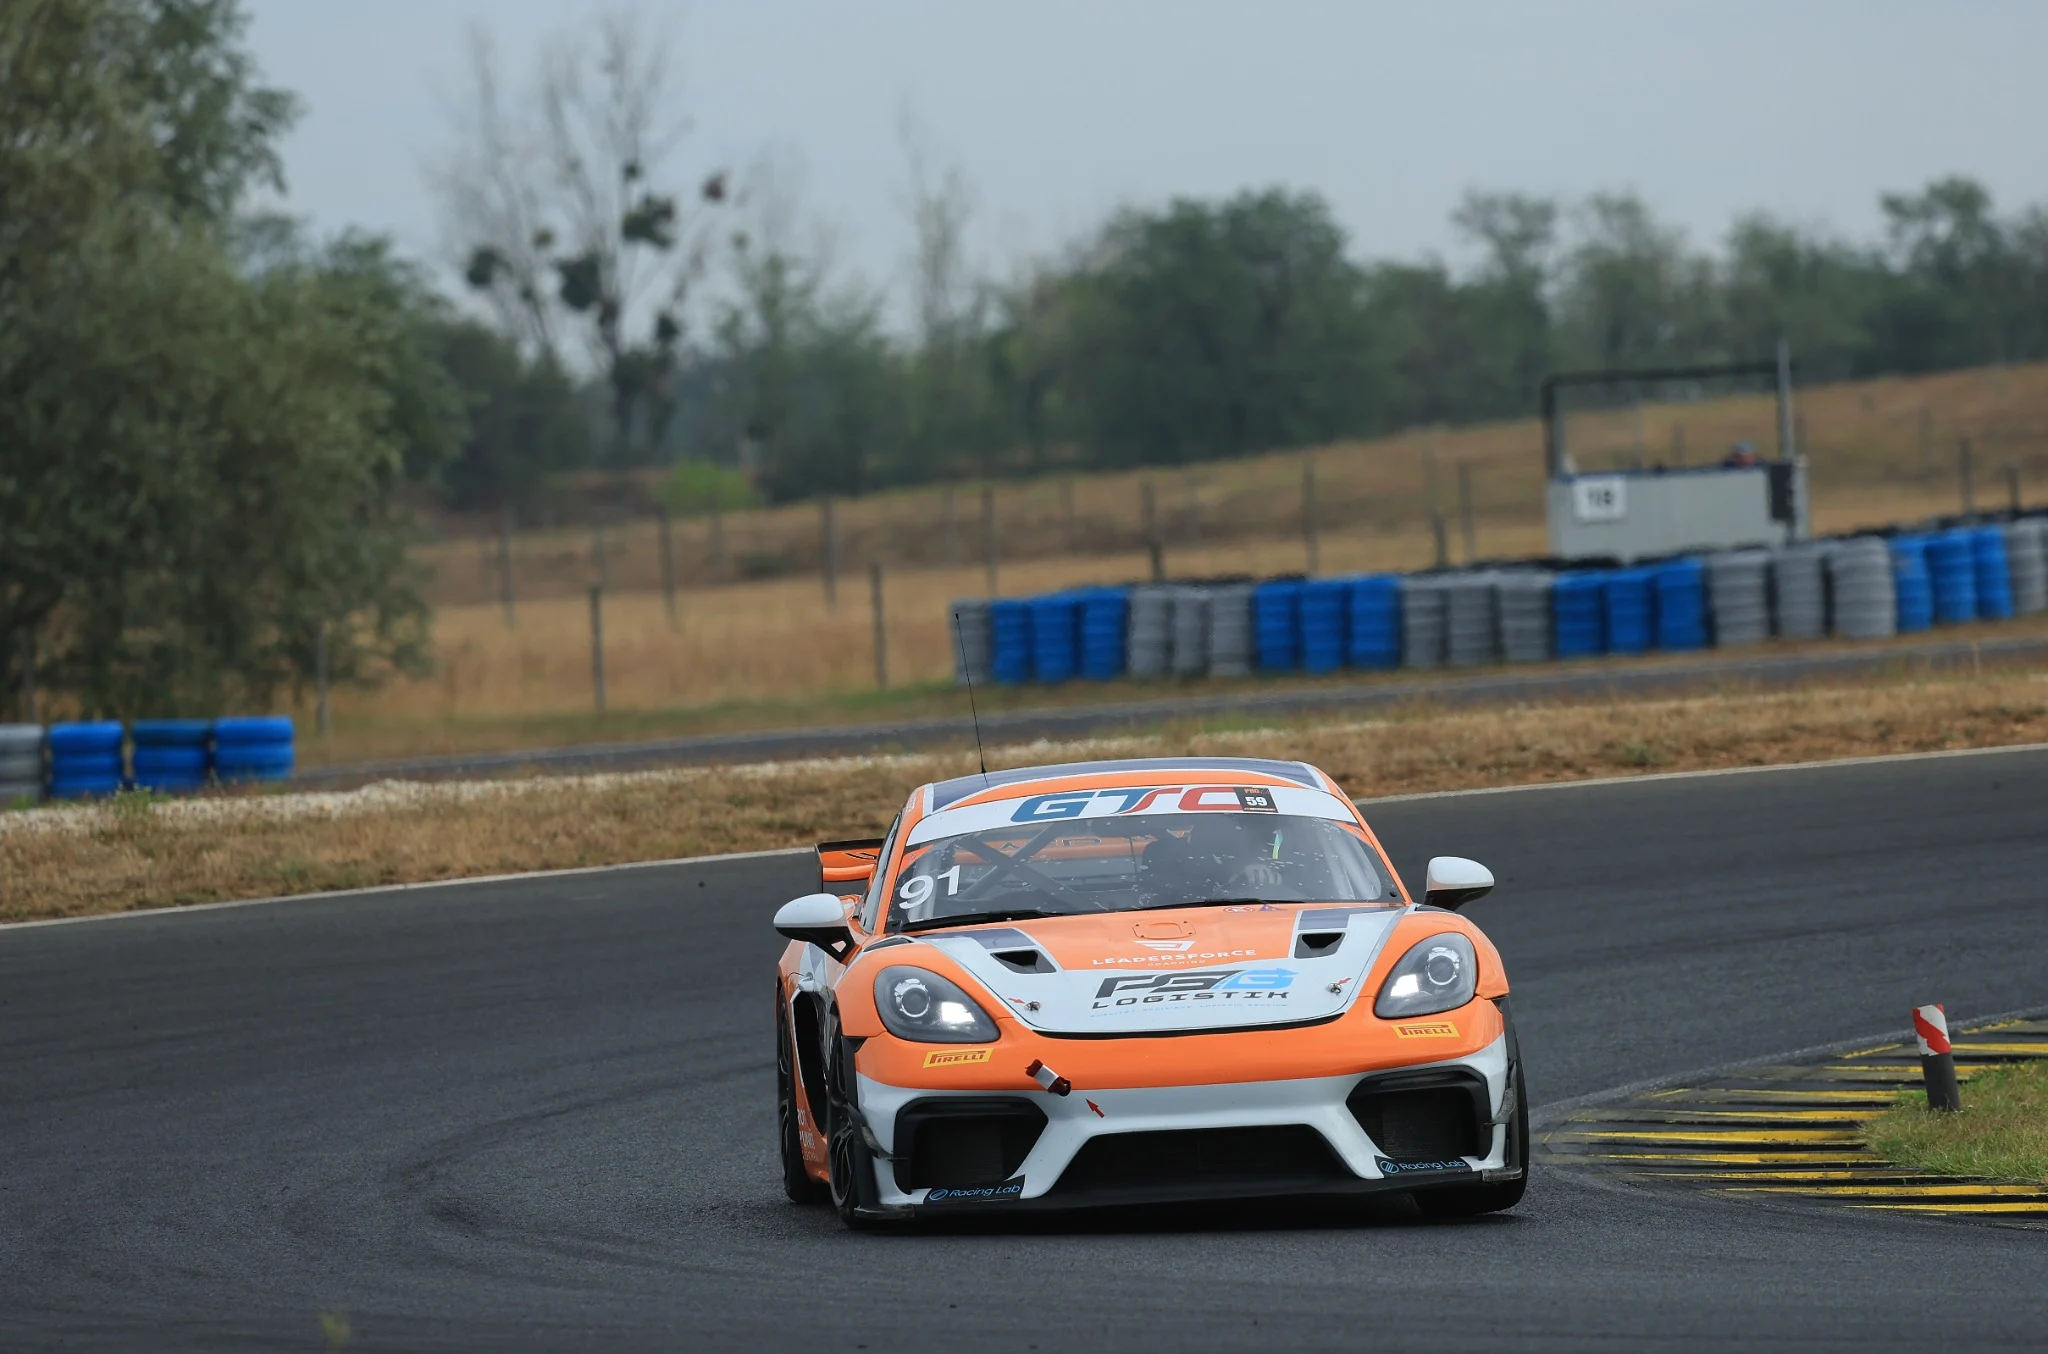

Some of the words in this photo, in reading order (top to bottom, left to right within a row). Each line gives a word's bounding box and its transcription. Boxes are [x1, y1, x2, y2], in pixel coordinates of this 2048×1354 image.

[1245, 796, 1268, 806] 59
[899, 865, 960, 909] 91
[1092, 949, 1257, 965] LEADERSFORCE
[1092, 991, 1290, 1009] LOGISTIK
[1398, 1024, 1453, 1036] PIRELLI
[929, 1050, 987, 1064] PIRELLI
[1398, 1161, 1443, 1170] Racing
[949, 1187, 994, 1197] Racing
[995, 1184, 1020, 1194] Lab
